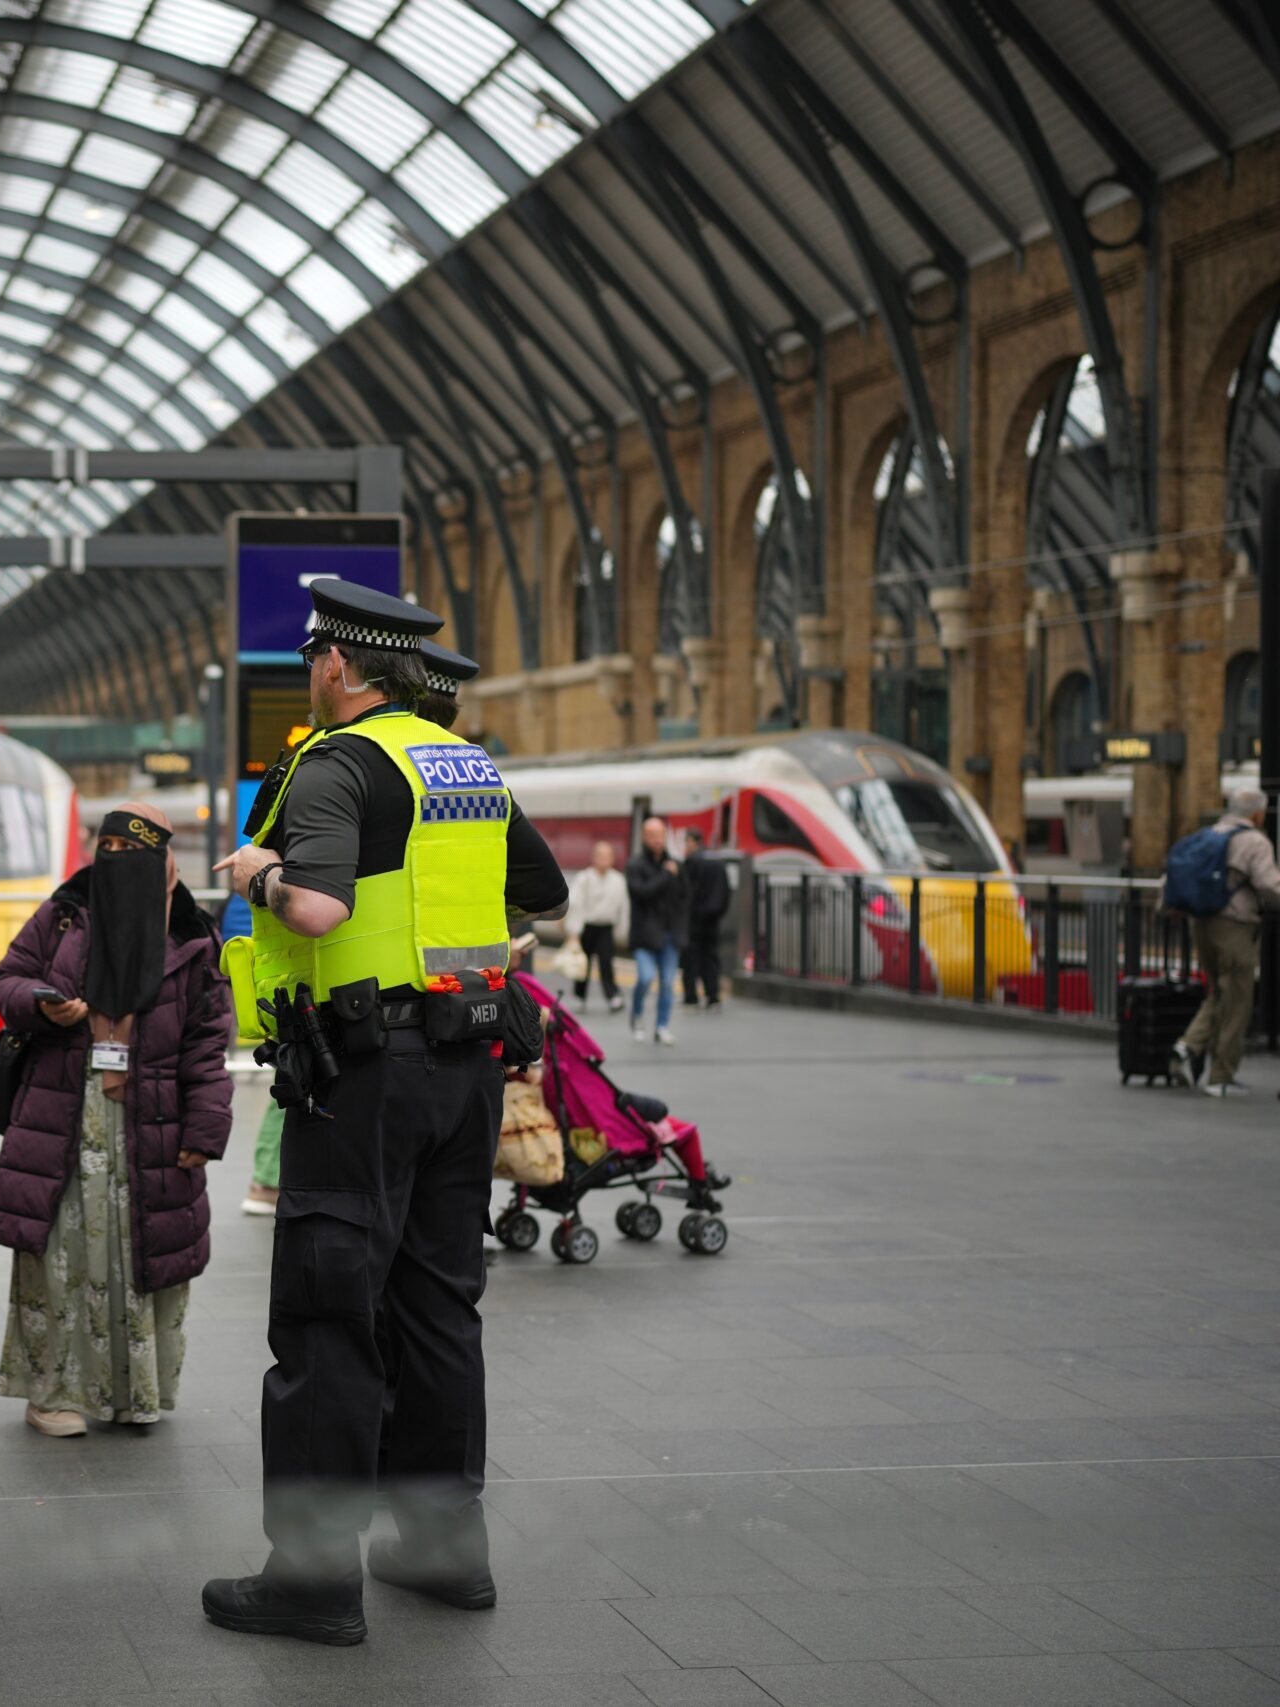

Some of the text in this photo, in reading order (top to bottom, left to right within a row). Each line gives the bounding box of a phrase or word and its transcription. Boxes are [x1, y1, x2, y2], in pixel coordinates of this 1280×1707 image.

[411, 749, 485, 760] BRITISH TRANSPORT
[417, 759, 500, 785] POLICE
[471, 1003, 498, 1024] MED
